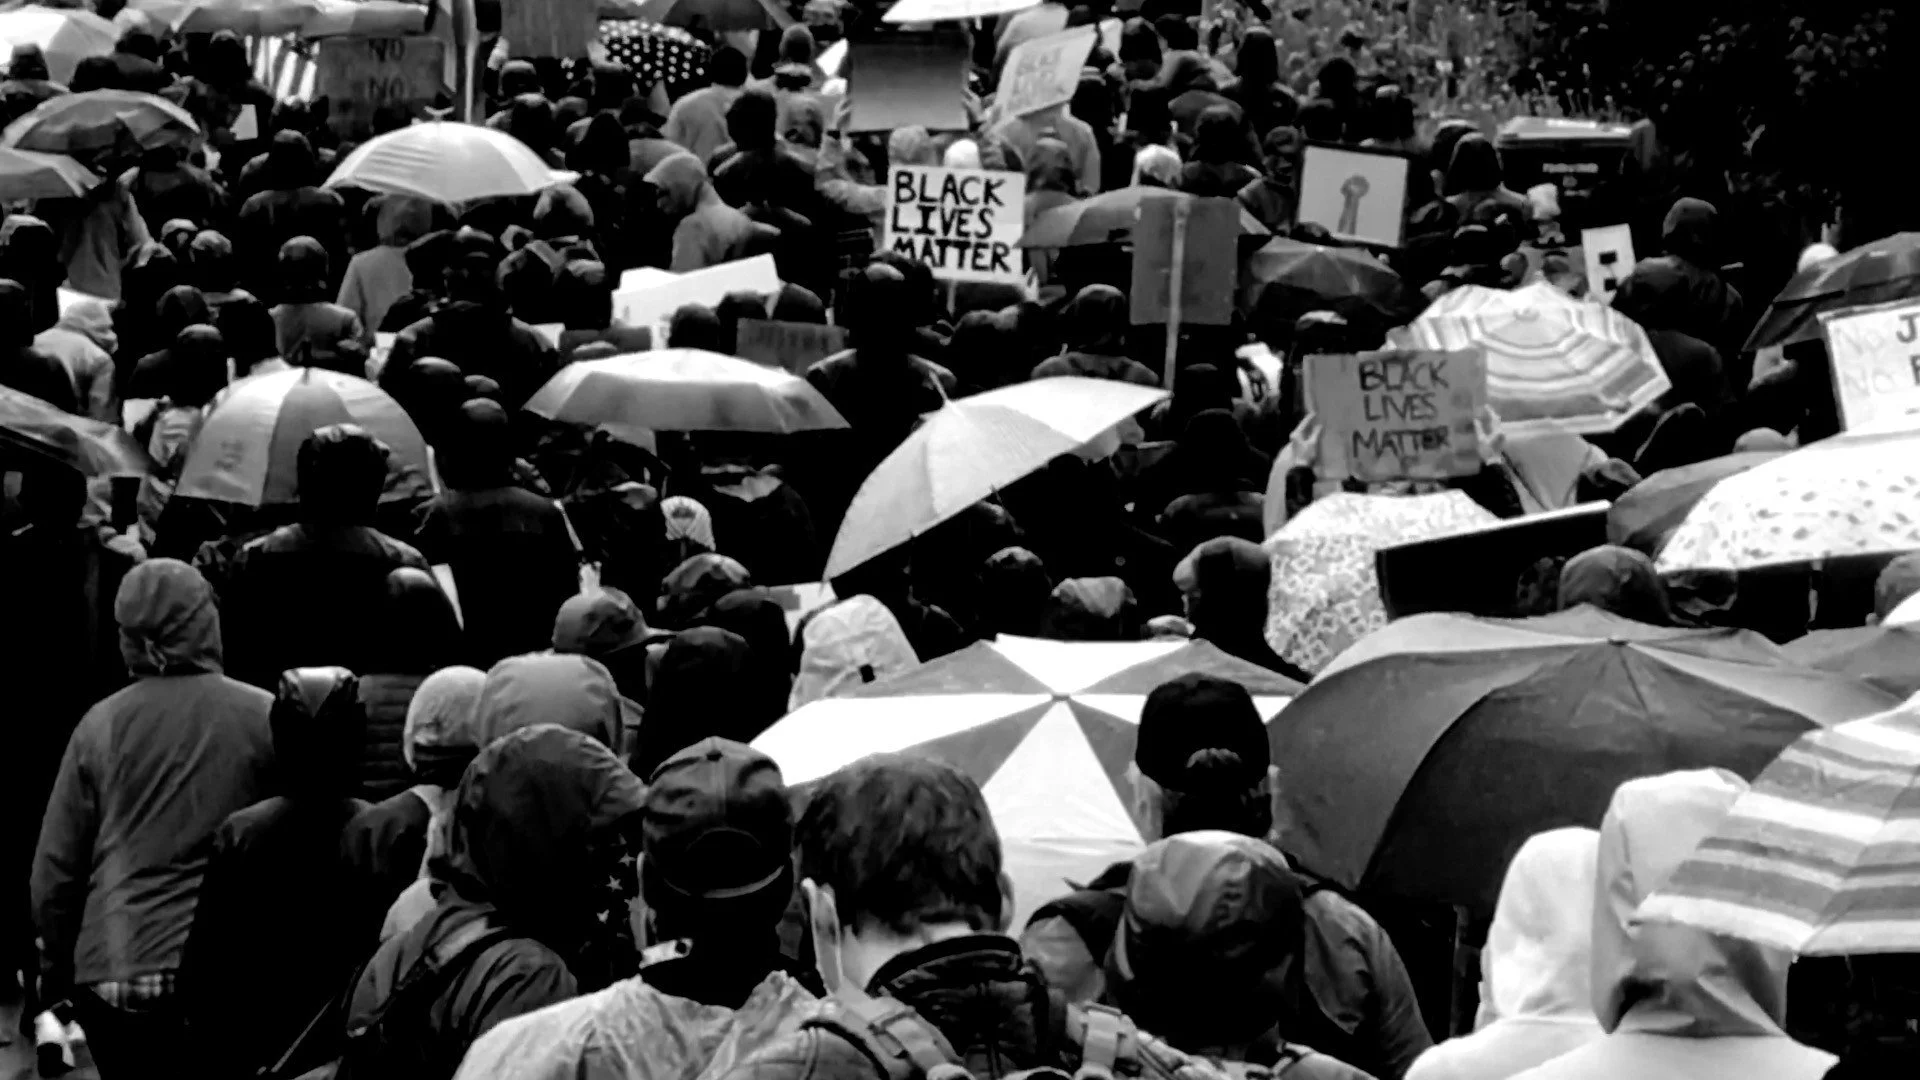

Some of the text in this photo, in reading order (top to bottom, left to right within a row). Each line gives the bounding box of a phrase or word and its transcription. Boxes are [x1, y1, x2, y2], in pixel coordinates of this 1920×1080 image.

[894, 170, 1006, 207] BLACK
[891, 204, 995, 239] LIVES
[892, 235, 1012, 274] MATTER
[1358, 355, 1450, 392] BLACK
[1363, 391, 1438, 422] LIVES
[1351, 424, 1450, 459] MATTER
